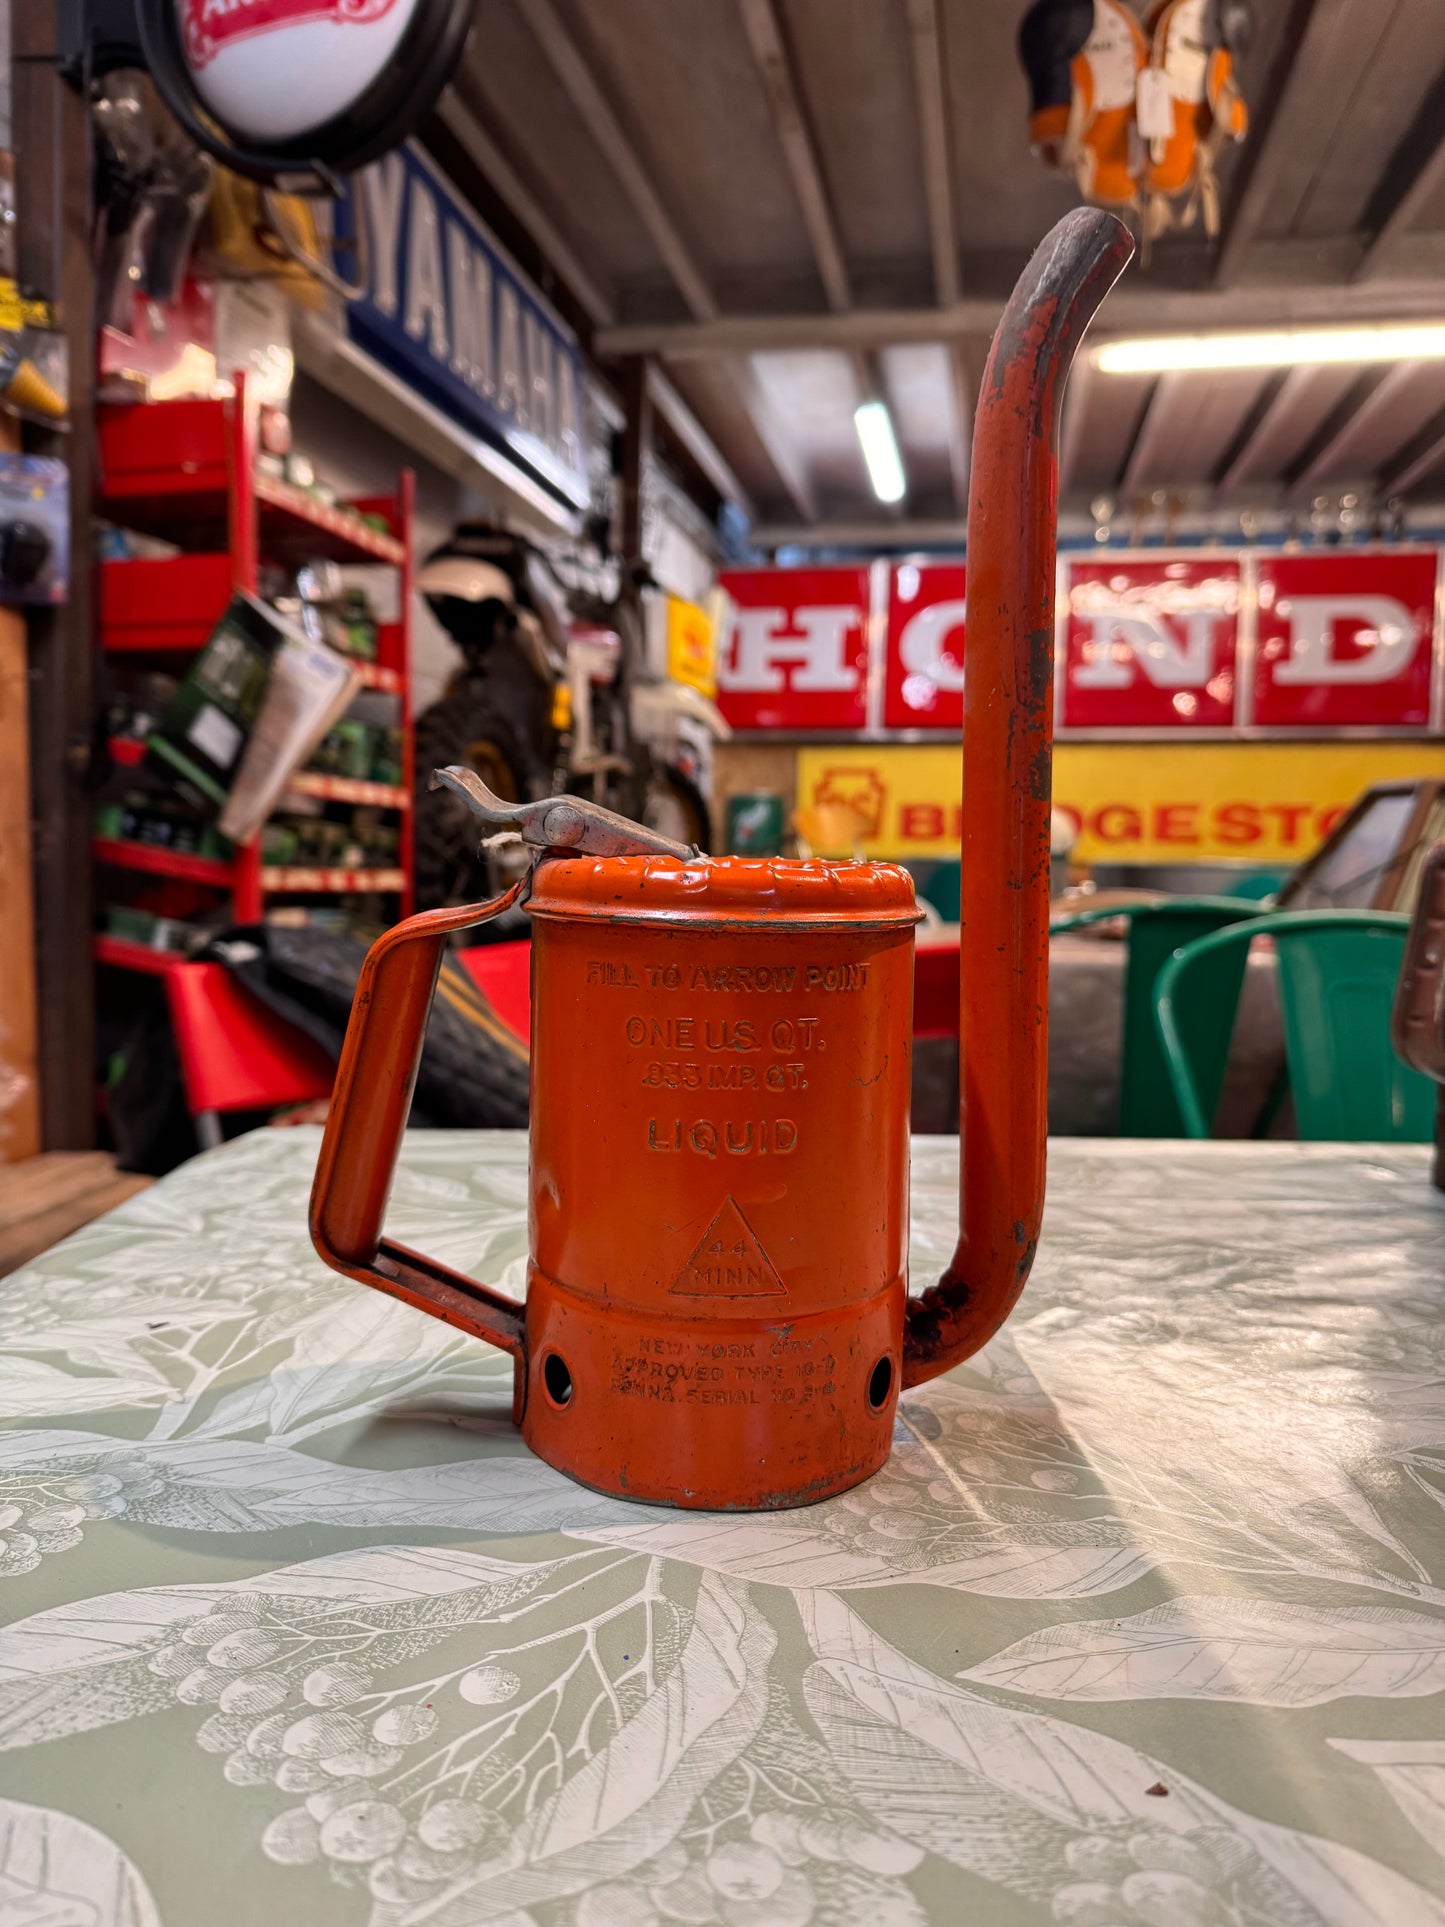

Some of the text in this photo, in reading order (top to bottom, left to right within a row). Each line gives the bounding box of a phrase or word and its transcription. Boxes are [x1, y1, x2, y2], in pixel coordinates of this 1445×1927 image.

[901, 802, 1350, 846] BGEST
[586, 961, 871, 992] FILL TO ARROW POINT
[625, 1016, 696, 1050] ONE
[770, 1016, 826, 1053] QT.
[648, 1118, 798, 1159] LIQUID
[708, 1239, 747, 1258] 44
[694, 1266, 762, 1286] MINN
[696, 1344, 756, 1360] YORK
[734, 1365, 784, 1381] TYPE
[686, 1389, 760, 1405] SERIAL
